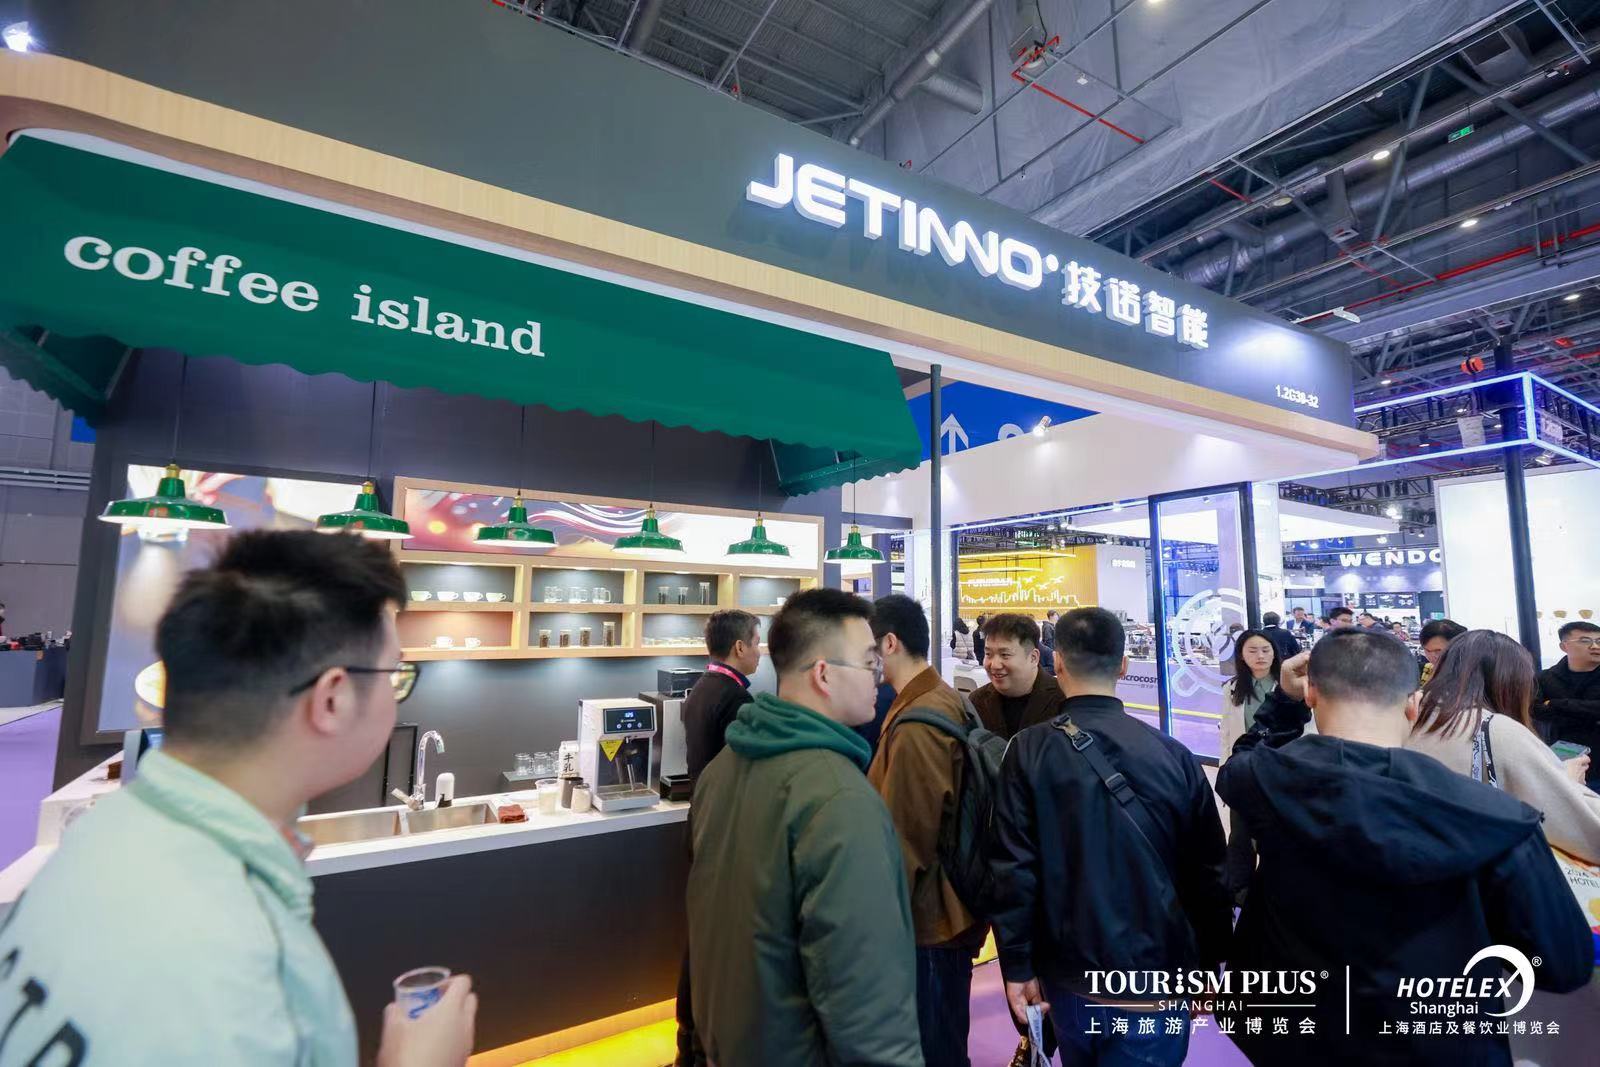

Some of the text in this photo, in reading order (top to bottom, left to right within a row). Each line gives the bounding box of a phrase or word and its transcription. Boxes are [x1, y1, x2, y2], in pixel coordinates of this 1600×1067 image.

[63, 235, 546, 357] coffee island
[746, 153, 1209, 350] JETINNO 技诺智能
[563, 752, 574, 773] 牛乳
